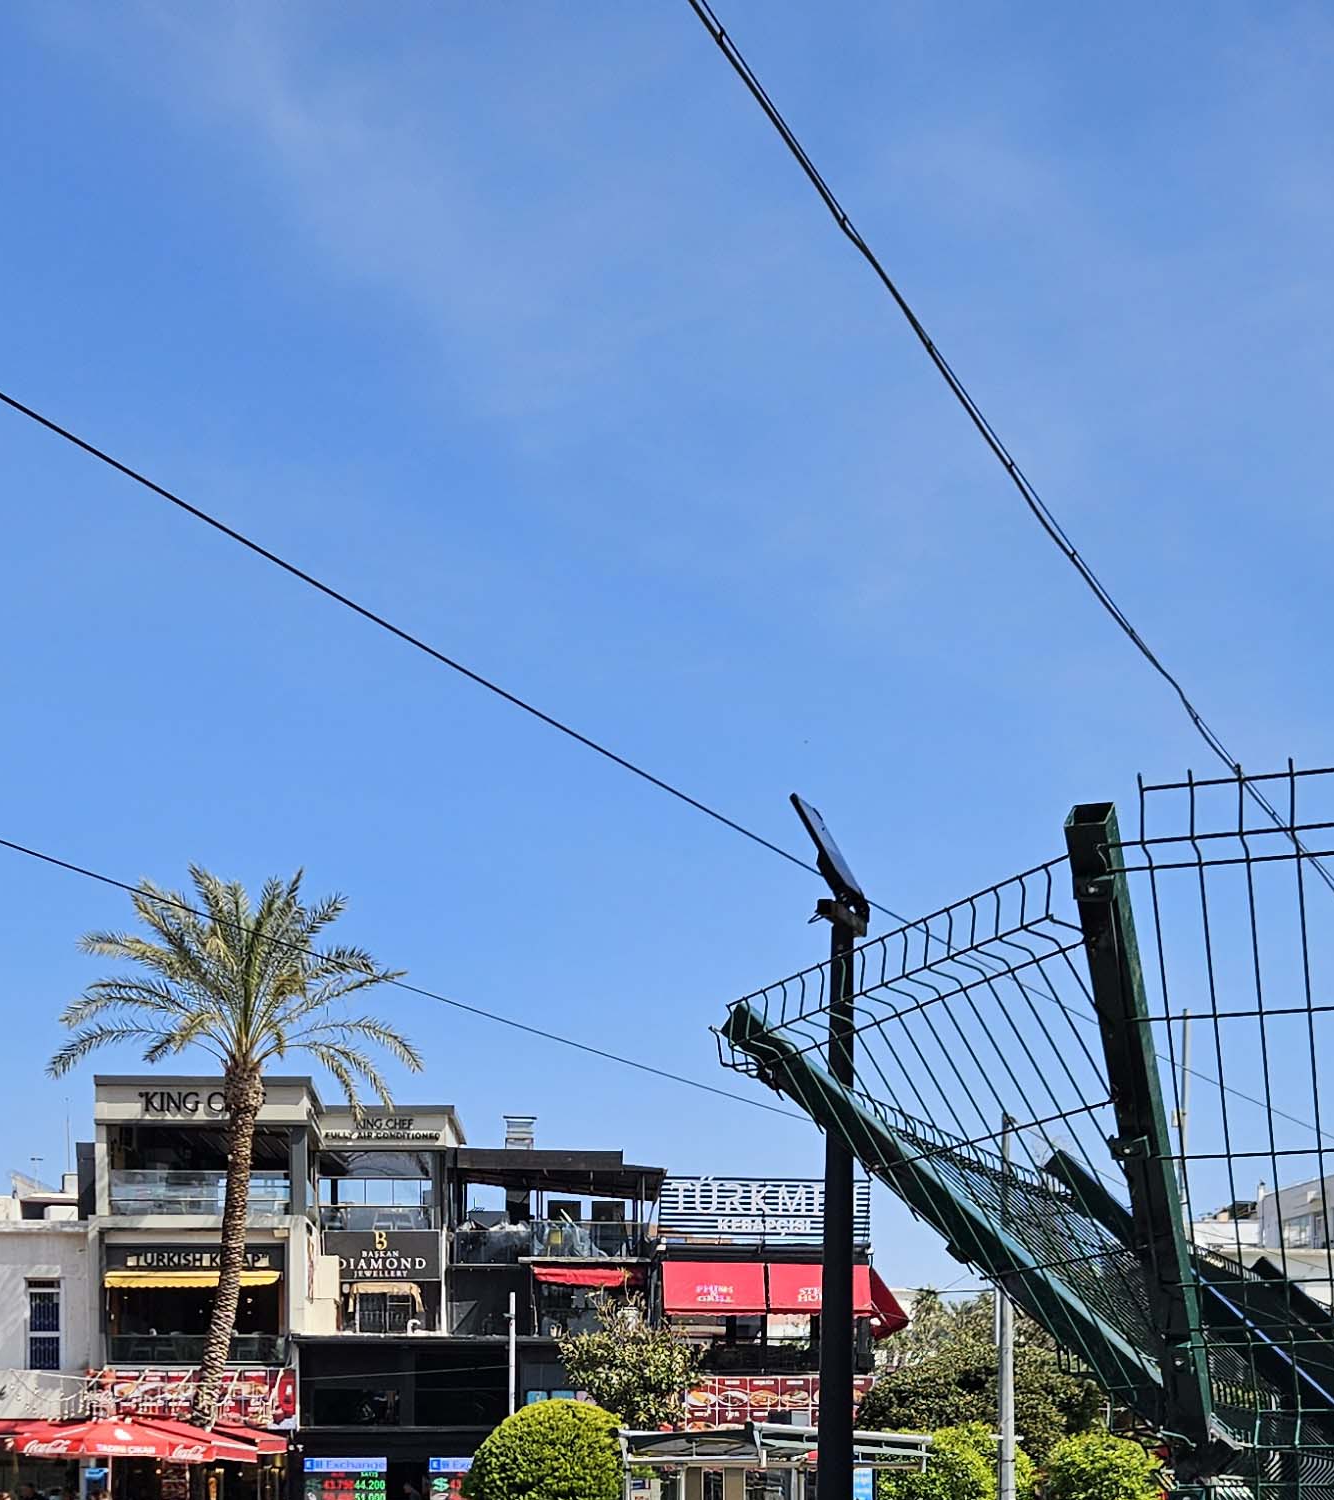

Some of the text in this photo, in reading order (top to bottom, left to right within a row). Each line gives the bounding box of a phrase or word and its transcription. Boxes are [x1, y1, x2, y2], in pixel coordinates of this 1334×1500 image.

[355, 1118, 414, 1130] KING CHEF
[325, 1130, 354, 1140] FULLY
[375, 1131, 441, 1141] CONDITIONED
[669, 1176, 862, 1215] TÜRKM
[361, 1250, 400, 1259] BAŞKAN
[339, 1257, 427, 1270] DIAMOND
[353, 1270, 409, 1279] JEWELLERY
[326, 1459, 386, 1470] Exchange
[354, 1479, 386, 1490] 44.200
